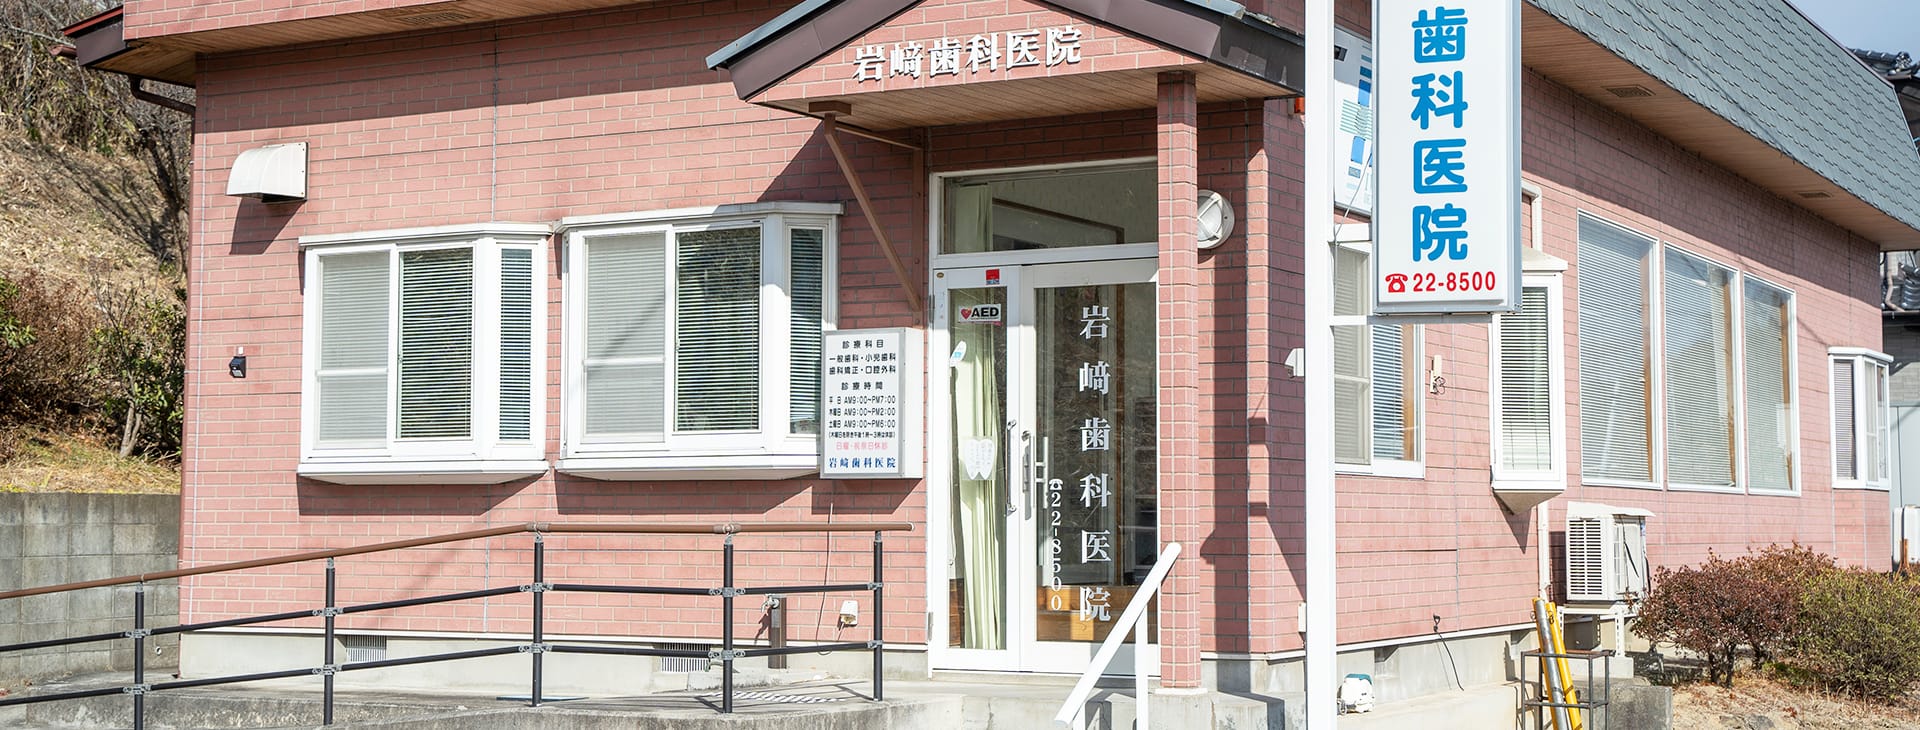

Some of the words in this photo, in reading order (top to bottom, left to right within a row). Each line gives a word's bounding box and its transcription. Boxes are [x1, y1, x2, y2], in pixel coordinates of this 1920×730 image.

[1411, 6, 1468, 262] 歯科医院
[1413, 271, 1496, 292] 22-8500
[971, 307, 999, 317] AED
[842, 339, 884, 349] 診療科目
[841, 381, 883, 390] 診療時間
